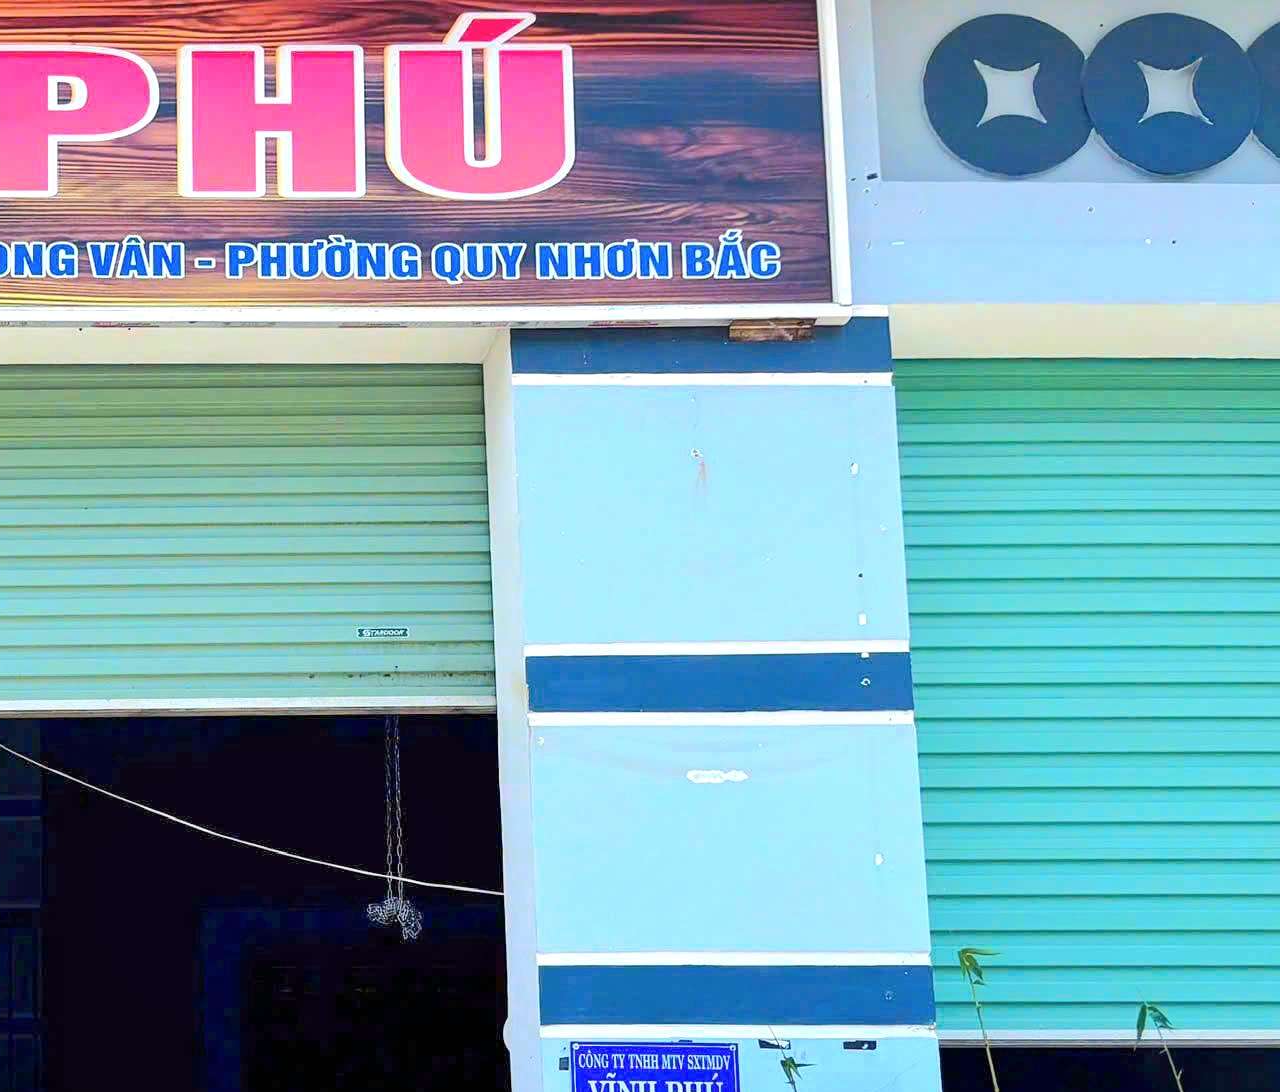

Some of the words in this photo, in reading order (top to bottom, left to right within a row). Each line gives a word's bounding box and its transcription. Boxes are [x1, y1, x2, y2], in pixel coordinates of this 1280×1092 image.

[79, 235, 184, 279] VÂN
[225, 235, 420, 280] PHƯỜNG
[431, 242, 525, 285] QUY
[535, 239, 671, 280] NHƠN
[682, 229, 781, 279] BẮC
[578, 1050, 609, 1068] CÔNG
[612, 1054, 625, 1069] TY
[628, 1054, 659, 1070] TNHH
[662, 1054, 685, 1070] MTV
[687, 1055, 731, 1070] SXTMDV
